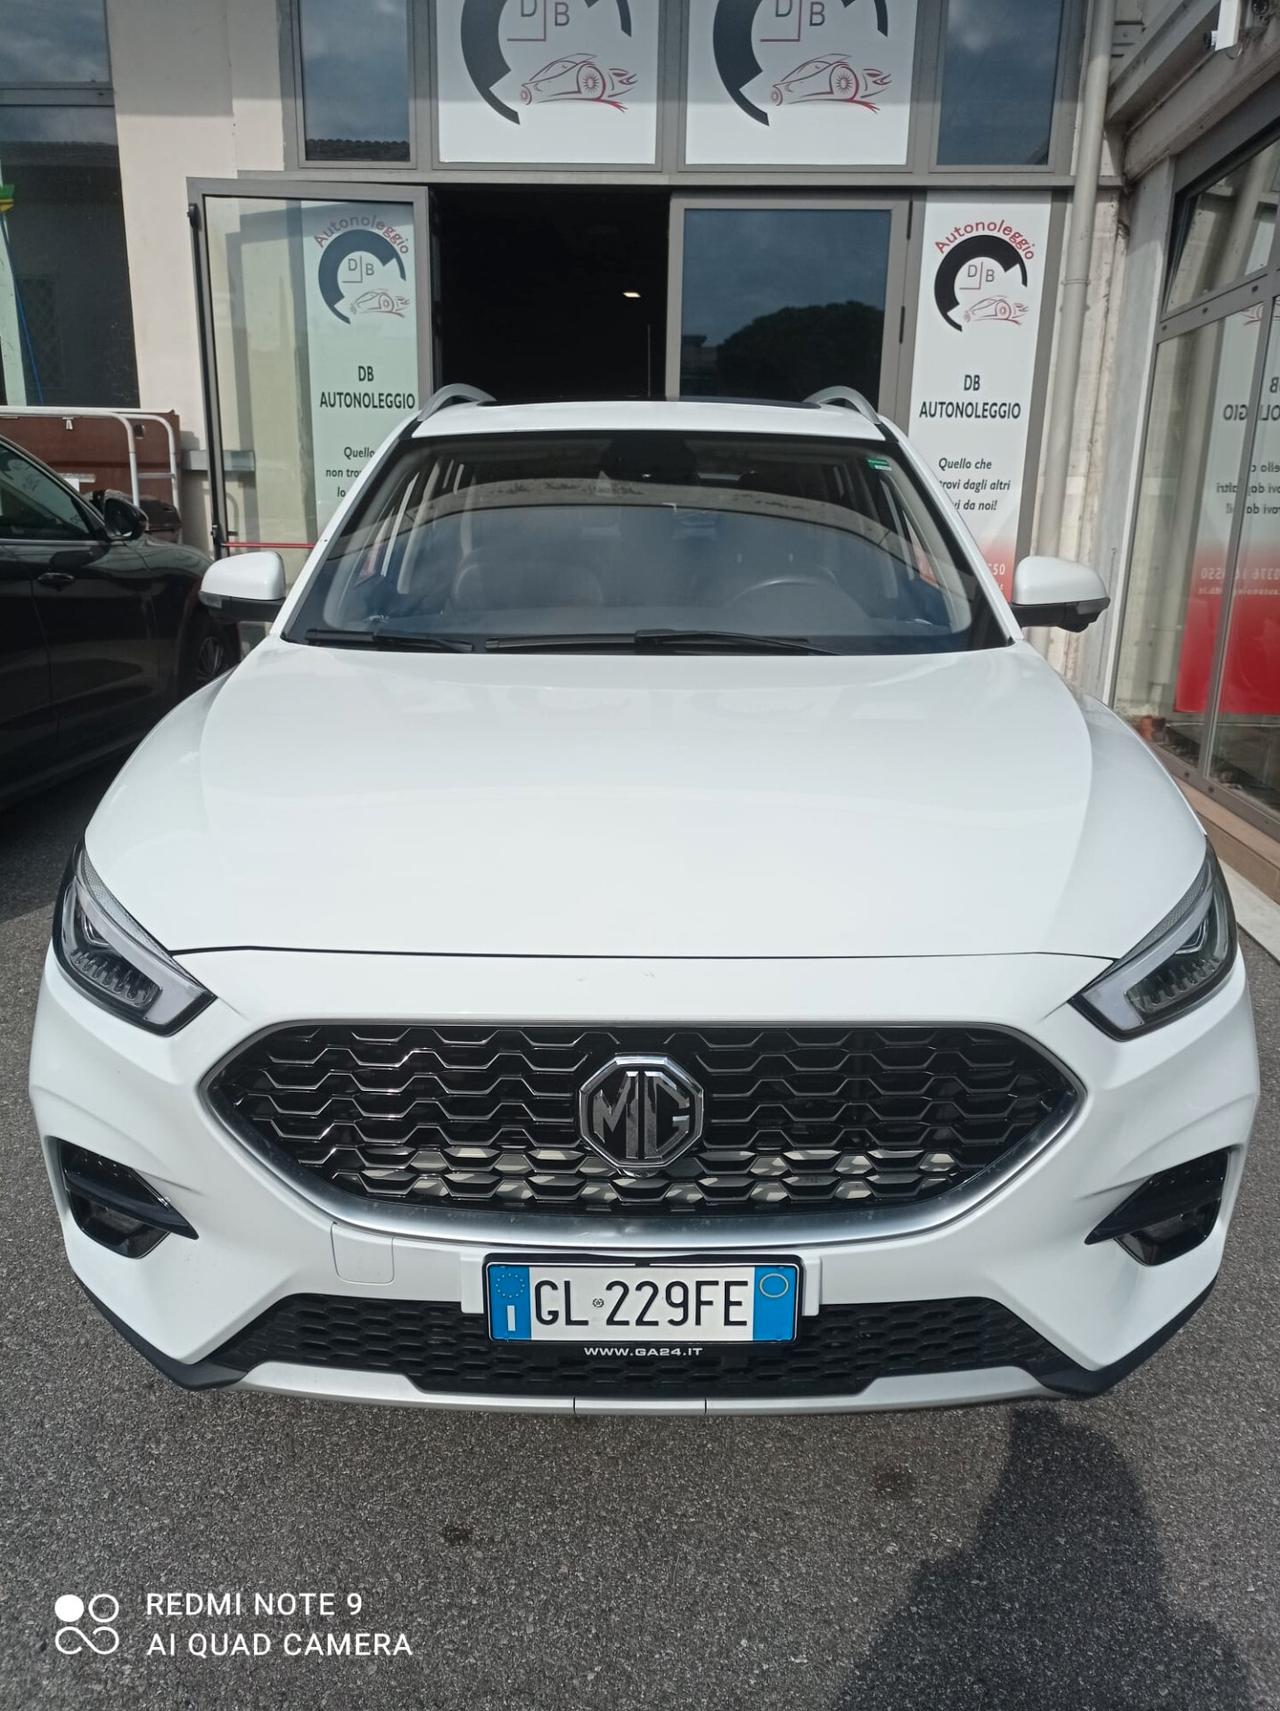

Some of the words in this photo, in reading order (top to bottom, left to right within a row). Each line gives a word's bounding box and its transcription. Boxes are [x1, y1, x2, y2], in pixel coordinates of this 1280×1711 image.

[314, 215, 409, 254] Autonoleggio
[935, 219, 1035, 260] Autonoleggio
[358, 365, 375, 382] DB
[963, 374, 981, 391] DB
[319, 391, 416, 409] AUTONOLEGGIO
[919, 401, 1021, 419] AUTONOLEGGIO
[938, 457, 972, 471] Quello
[974, 458, 992, 469] che
[325, 468, 344, 478] non
[337, 486, 346, 498] lo
[963, 479, 988, 493] dagli
[990, 480, 1011, 490] altri
[963, 500, 976, 511] da
[978, 500, 998, 511] noi!
[592, 1070, 691, 1160] MG
[583, 1347, 704, 1357] WWW.GA24.IT
